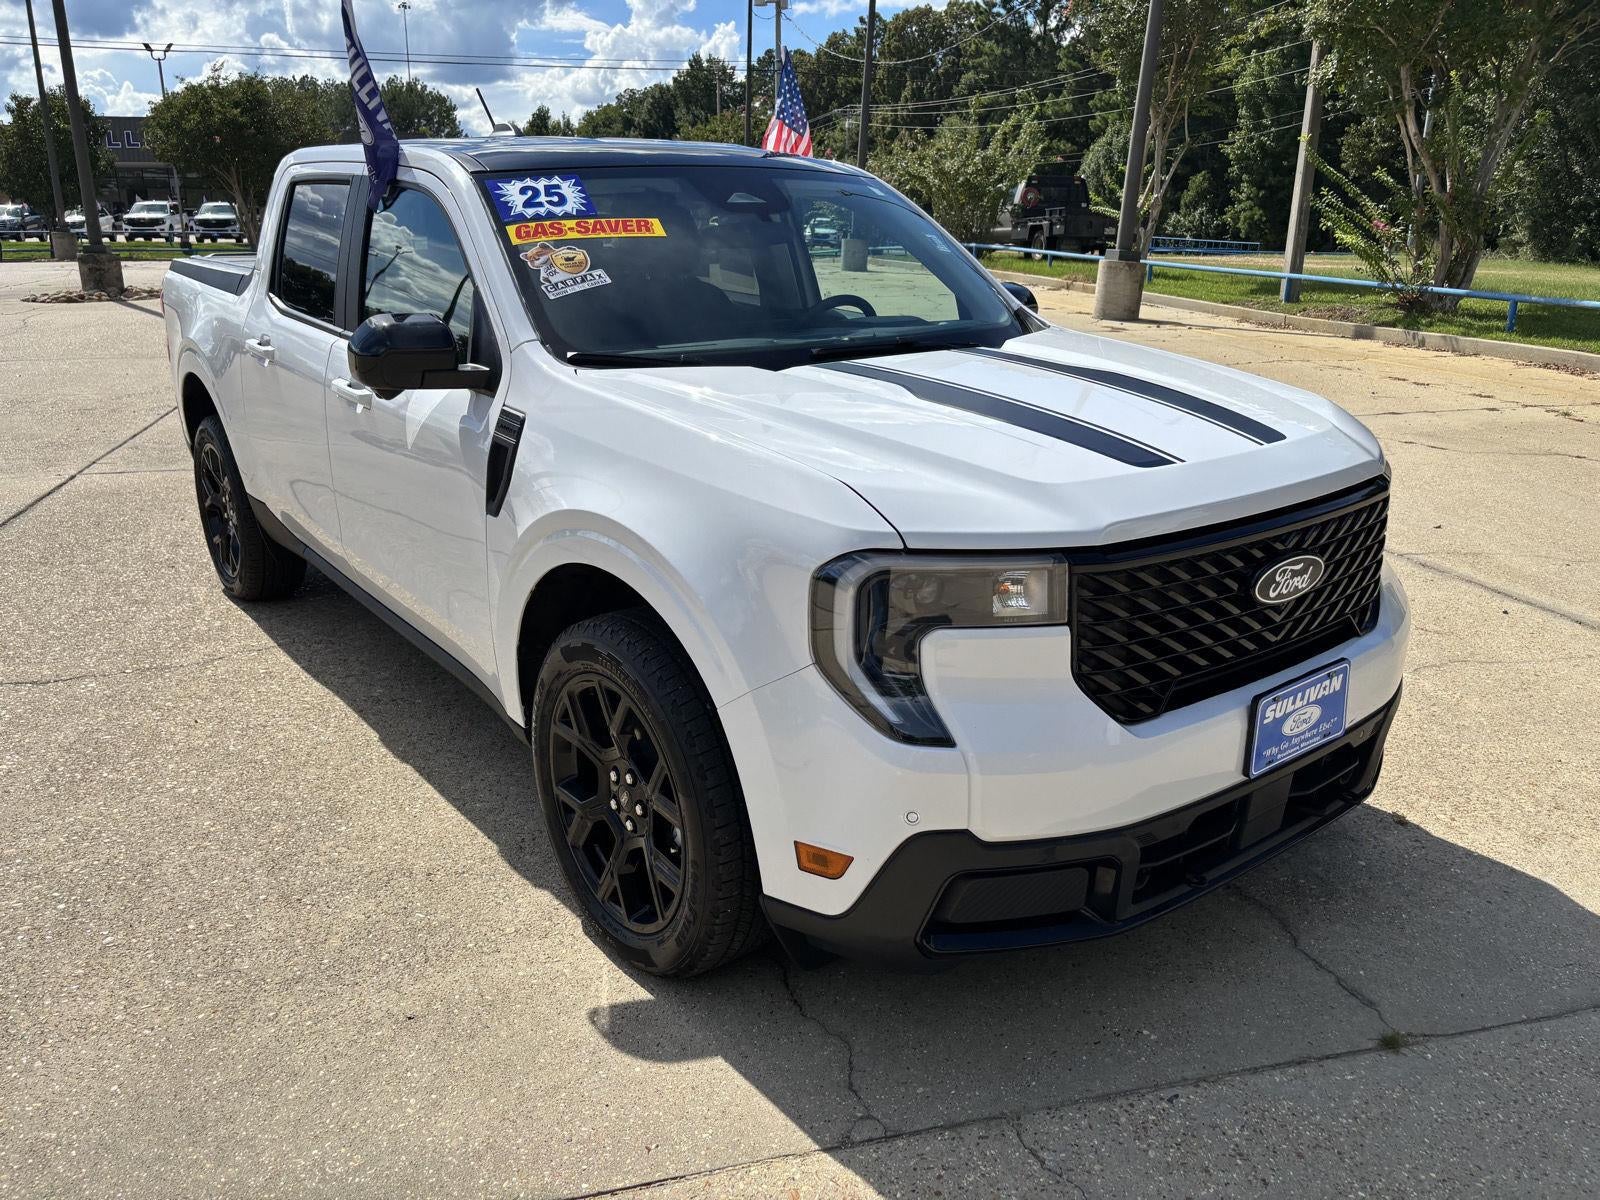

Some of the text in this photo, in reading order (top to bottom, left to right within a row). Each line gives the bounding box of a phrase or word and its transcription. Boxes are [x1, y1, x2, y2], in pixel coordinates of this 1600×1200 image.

[519, 184, 568, 208] 25
[514, 219, 655, 241] GAS-SAVER
[547, 272, 604, 292] CARFAX
[1270, 562, 1312, 598] Ford
[1263, 674, 1344, 724] SULLIVAN
[1290, 711, 1313, 732] Ford
